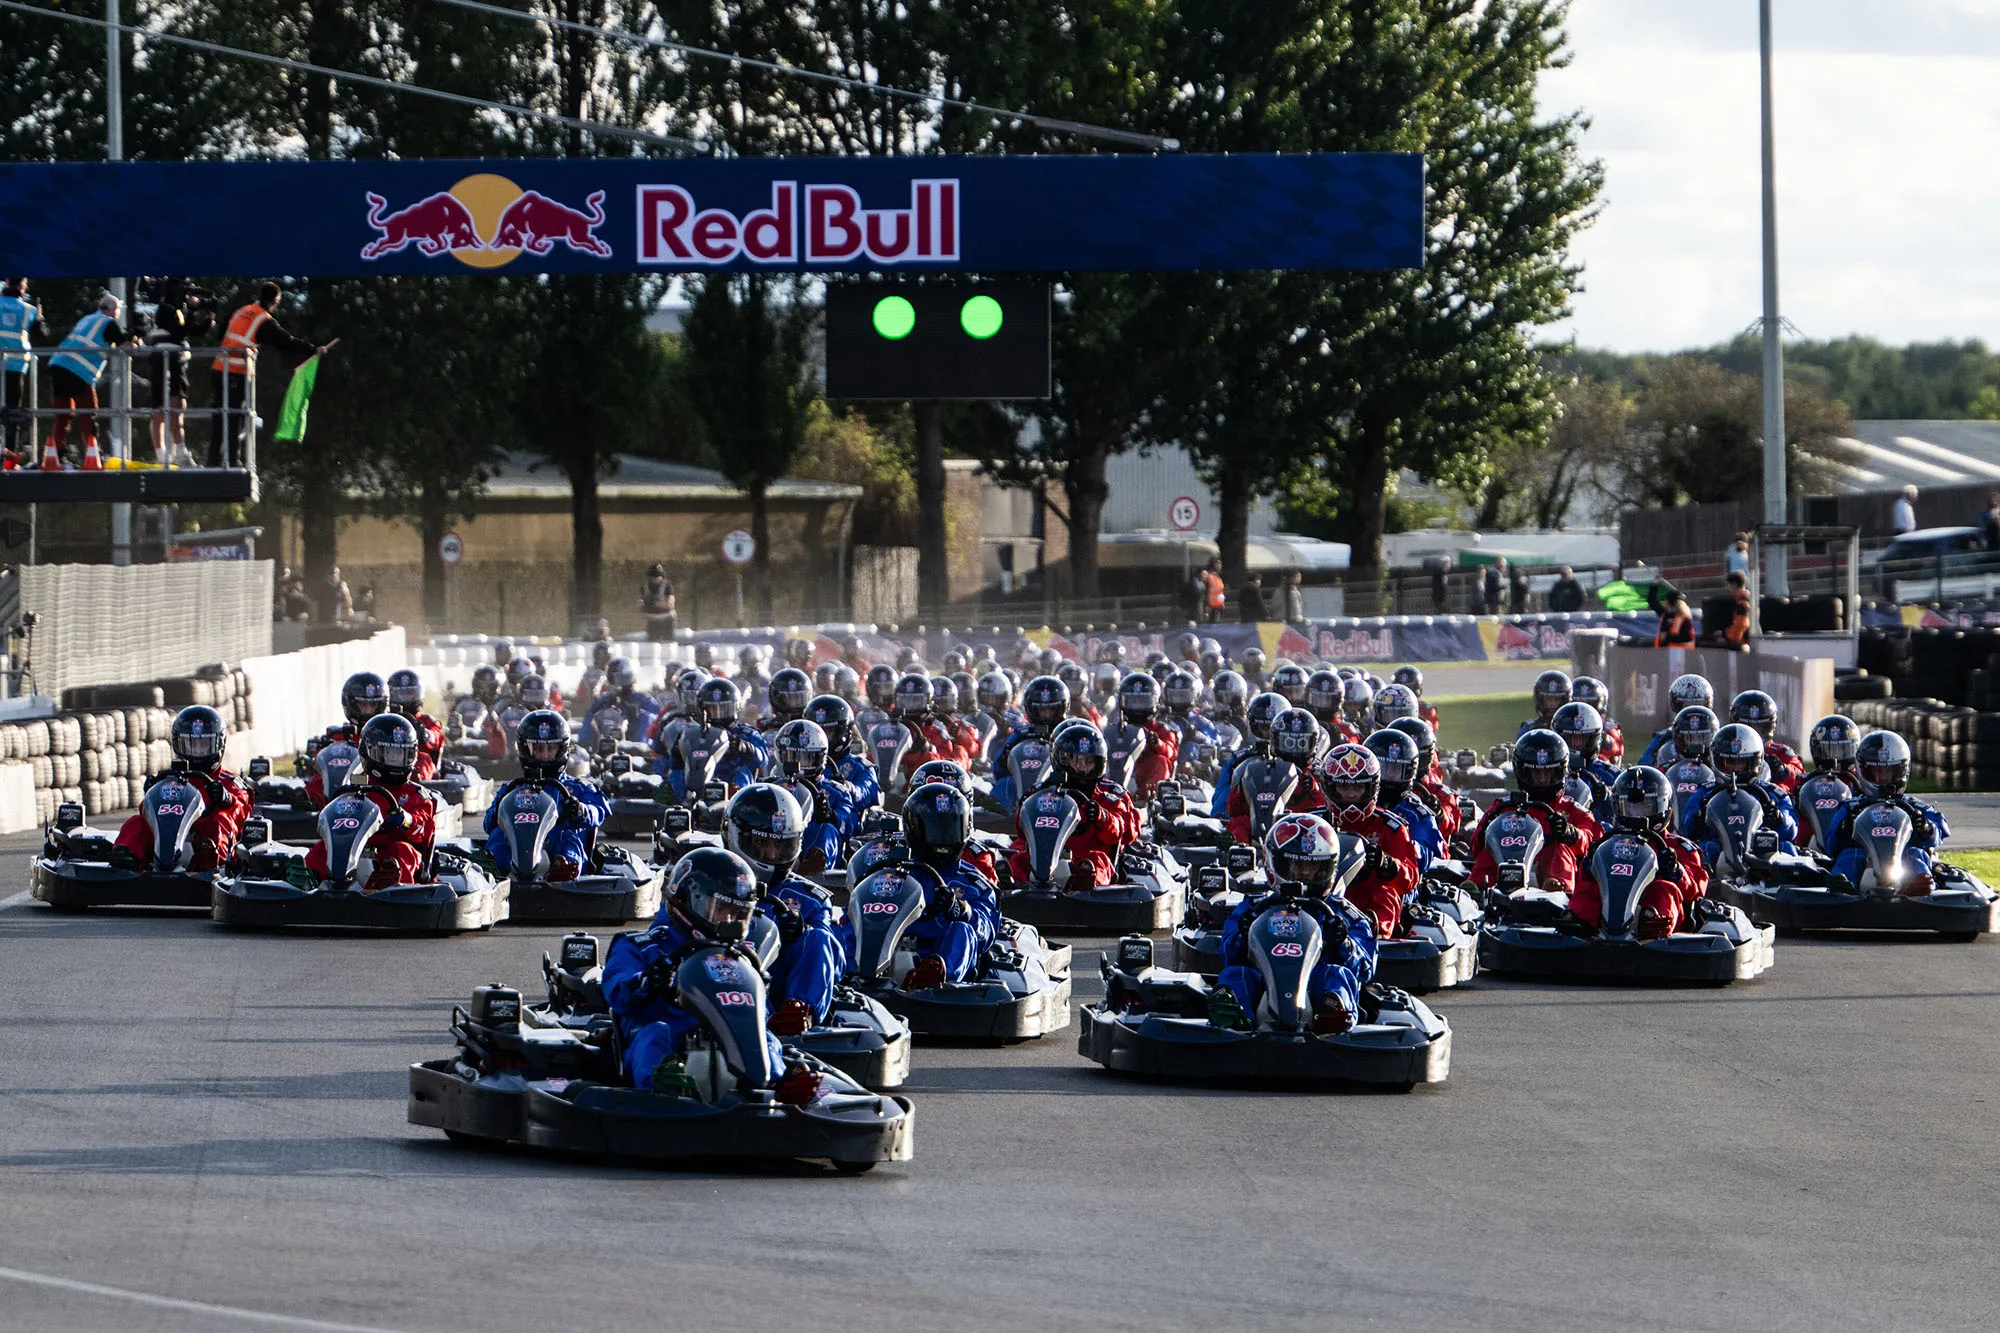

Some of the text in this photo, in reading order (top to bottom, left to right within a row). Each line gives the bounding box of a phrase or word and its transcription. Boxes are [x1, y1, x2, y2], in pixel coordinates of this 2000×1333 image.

[637, 179, 960, 263] Red Bull
[1176, 505, 1192, 520] 15
[1320, 629, 1393, 657] Red Bull
[1021, 760, 1042, 769] 99
[1677, 783, 1698, 793] 50
[158, 804, 184, 815] 54
[1815, 799, 1839, 809] 29
[332, 817, 360, 830] 70
[514, 813, 540, 824] 28
[1034, 816, 1060, 828] 52
[1727, 816, 1746, 825] 71
[751, 828, 767, 838] GIVES
[1872, 827, 1897, 836] 82
[1500, 836, 1528, 847] 84
[1283, 852, 1298, 860] GIVES
[1610, 863, 1634, 876] 21
[713, 892, 745, 907] GIVES YOU
[863, 903, 899, 914] 100
[1271, 942, 1303, 957] 65
[716, 991, 756, 1006] 101
